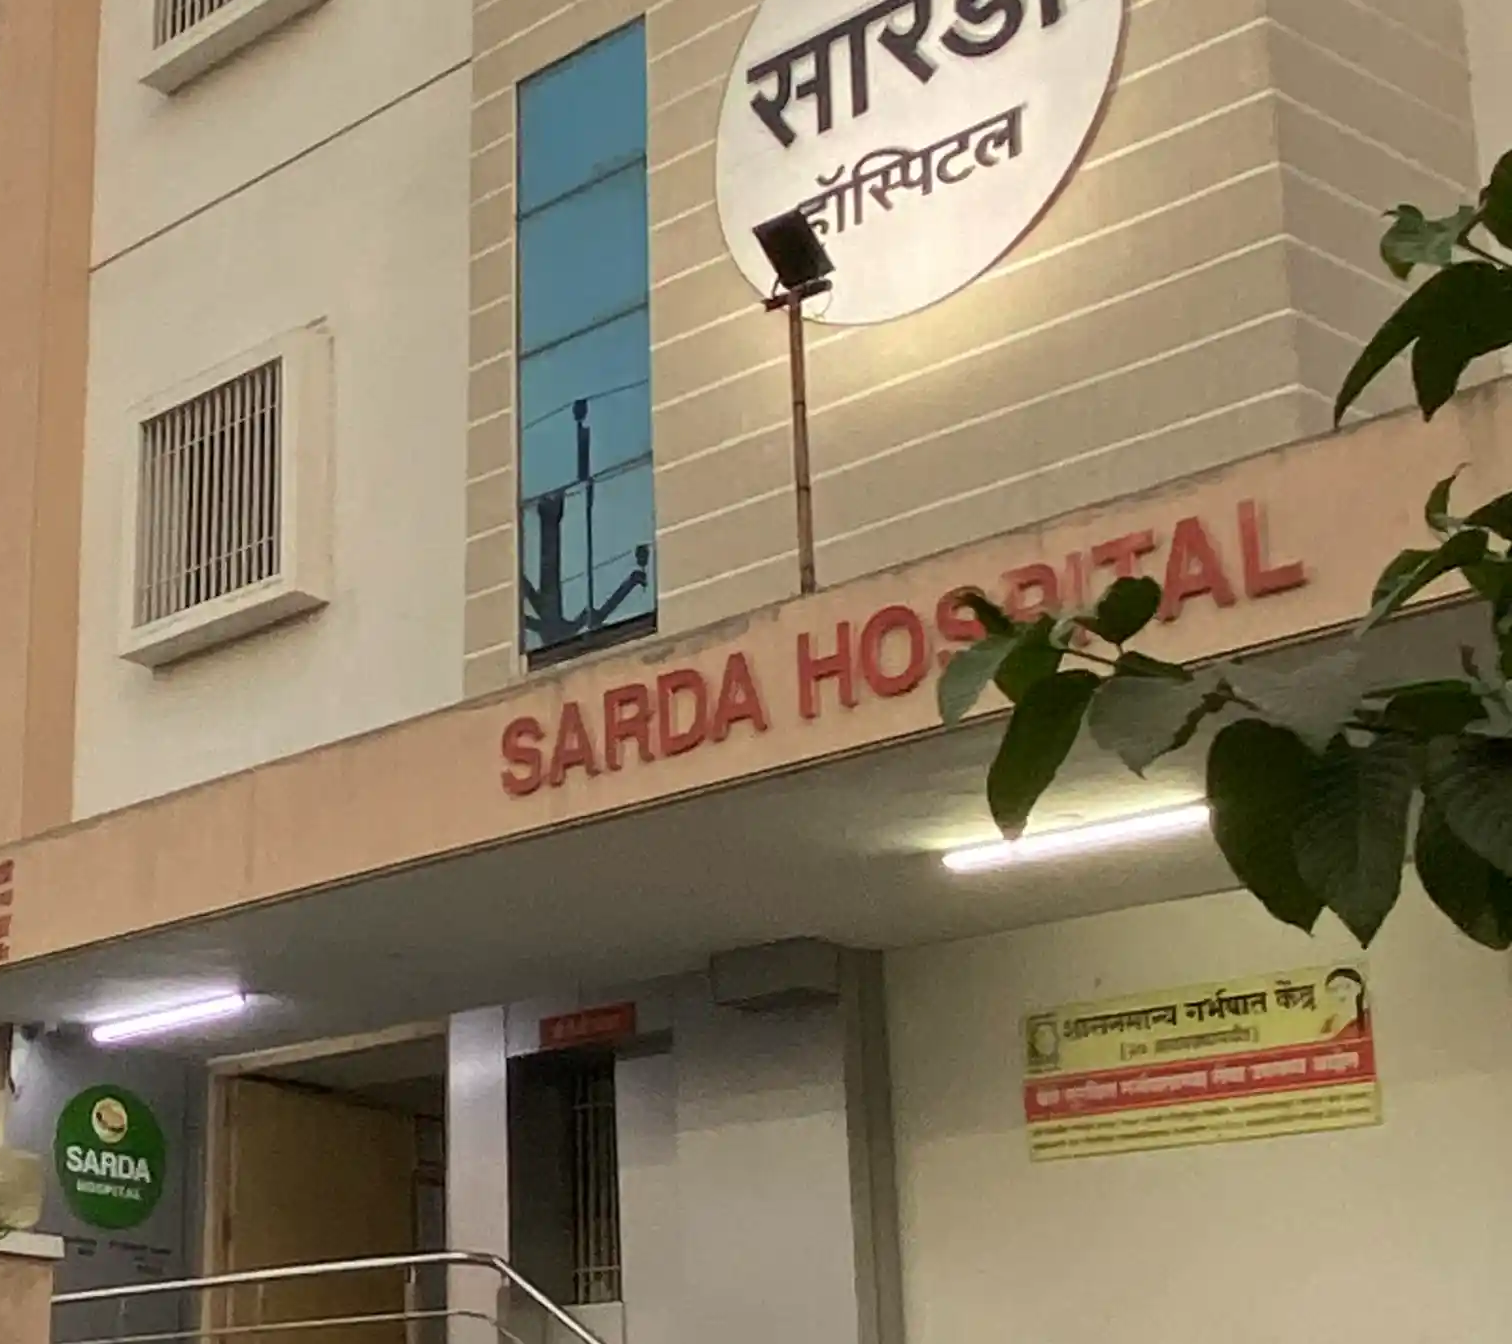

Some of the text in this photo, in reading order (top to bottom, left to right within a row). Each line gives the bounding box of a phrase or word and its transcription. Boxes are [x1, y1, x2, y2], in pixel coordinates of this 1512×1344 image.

[799, 103, 1028, 248] हॉस्पिटल
[501, 652, 767, 797] SARDA
[66, 1145, 152, 1183] SARDA
